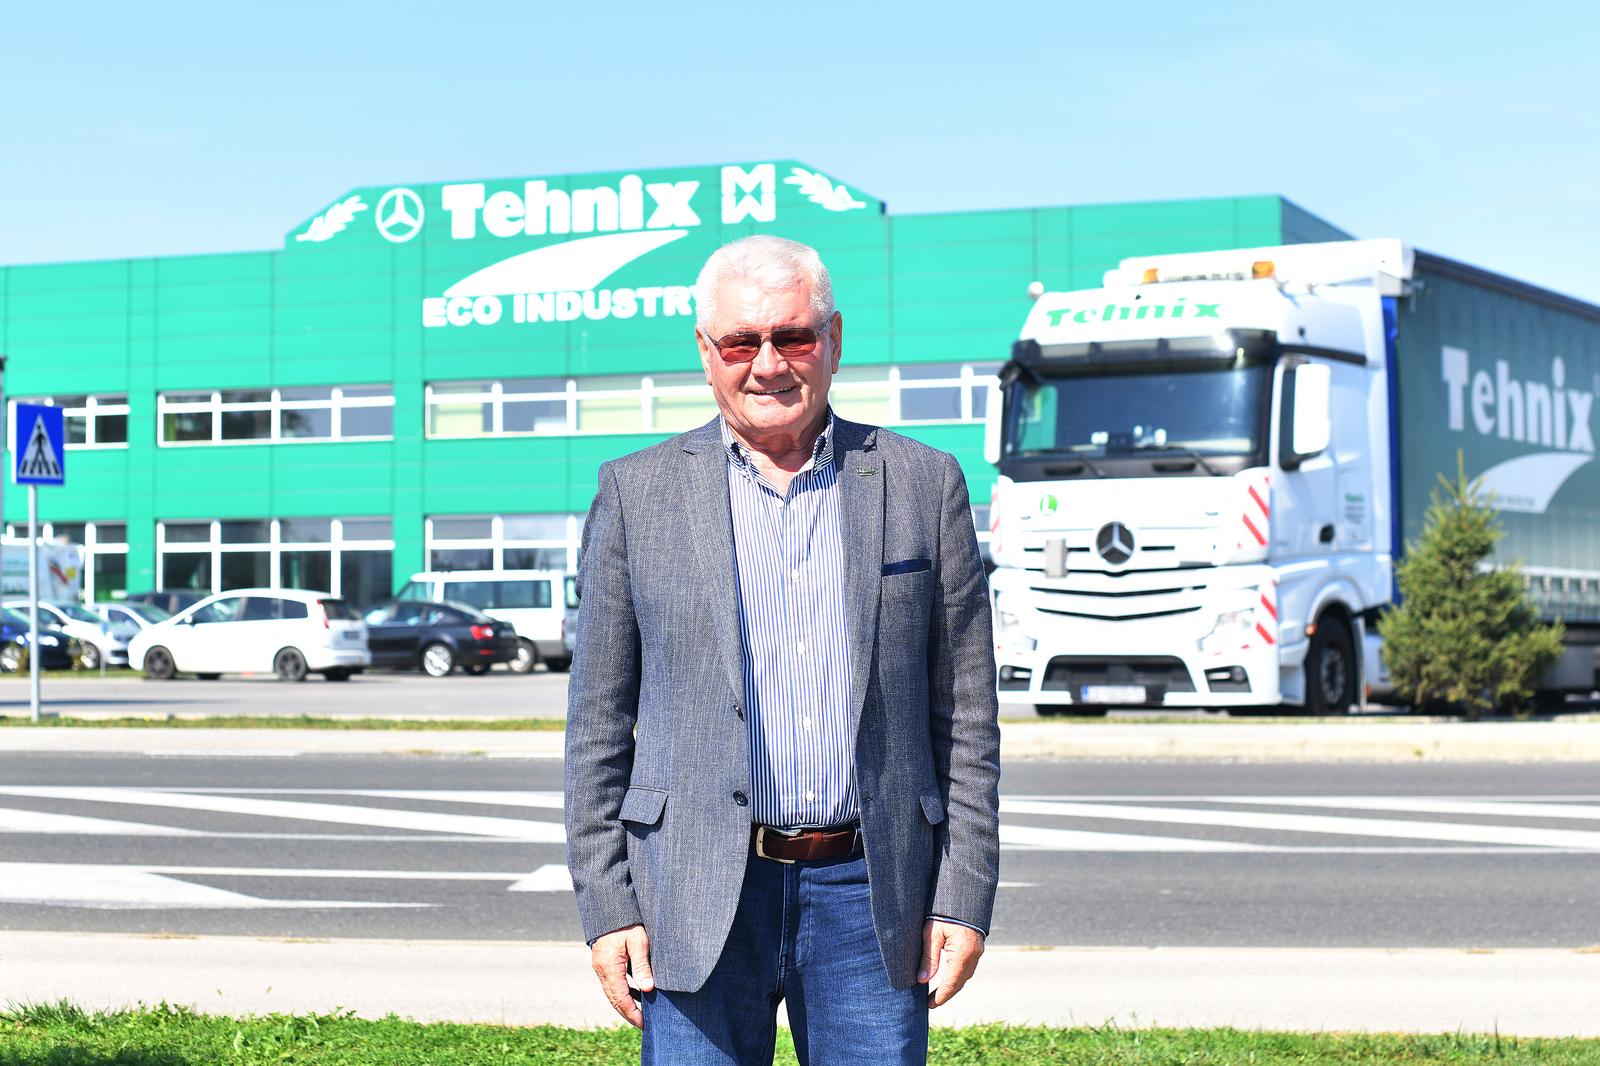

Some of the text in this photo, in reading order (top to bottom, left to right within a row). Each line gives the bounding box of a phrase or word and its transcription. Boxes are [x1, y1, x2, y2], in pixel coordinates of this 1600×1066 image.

[441, 174, 702, 240] Tehnix
[422, 295, 502, 328] ECO
[1441, 344, 1596, 452] Tehnix
